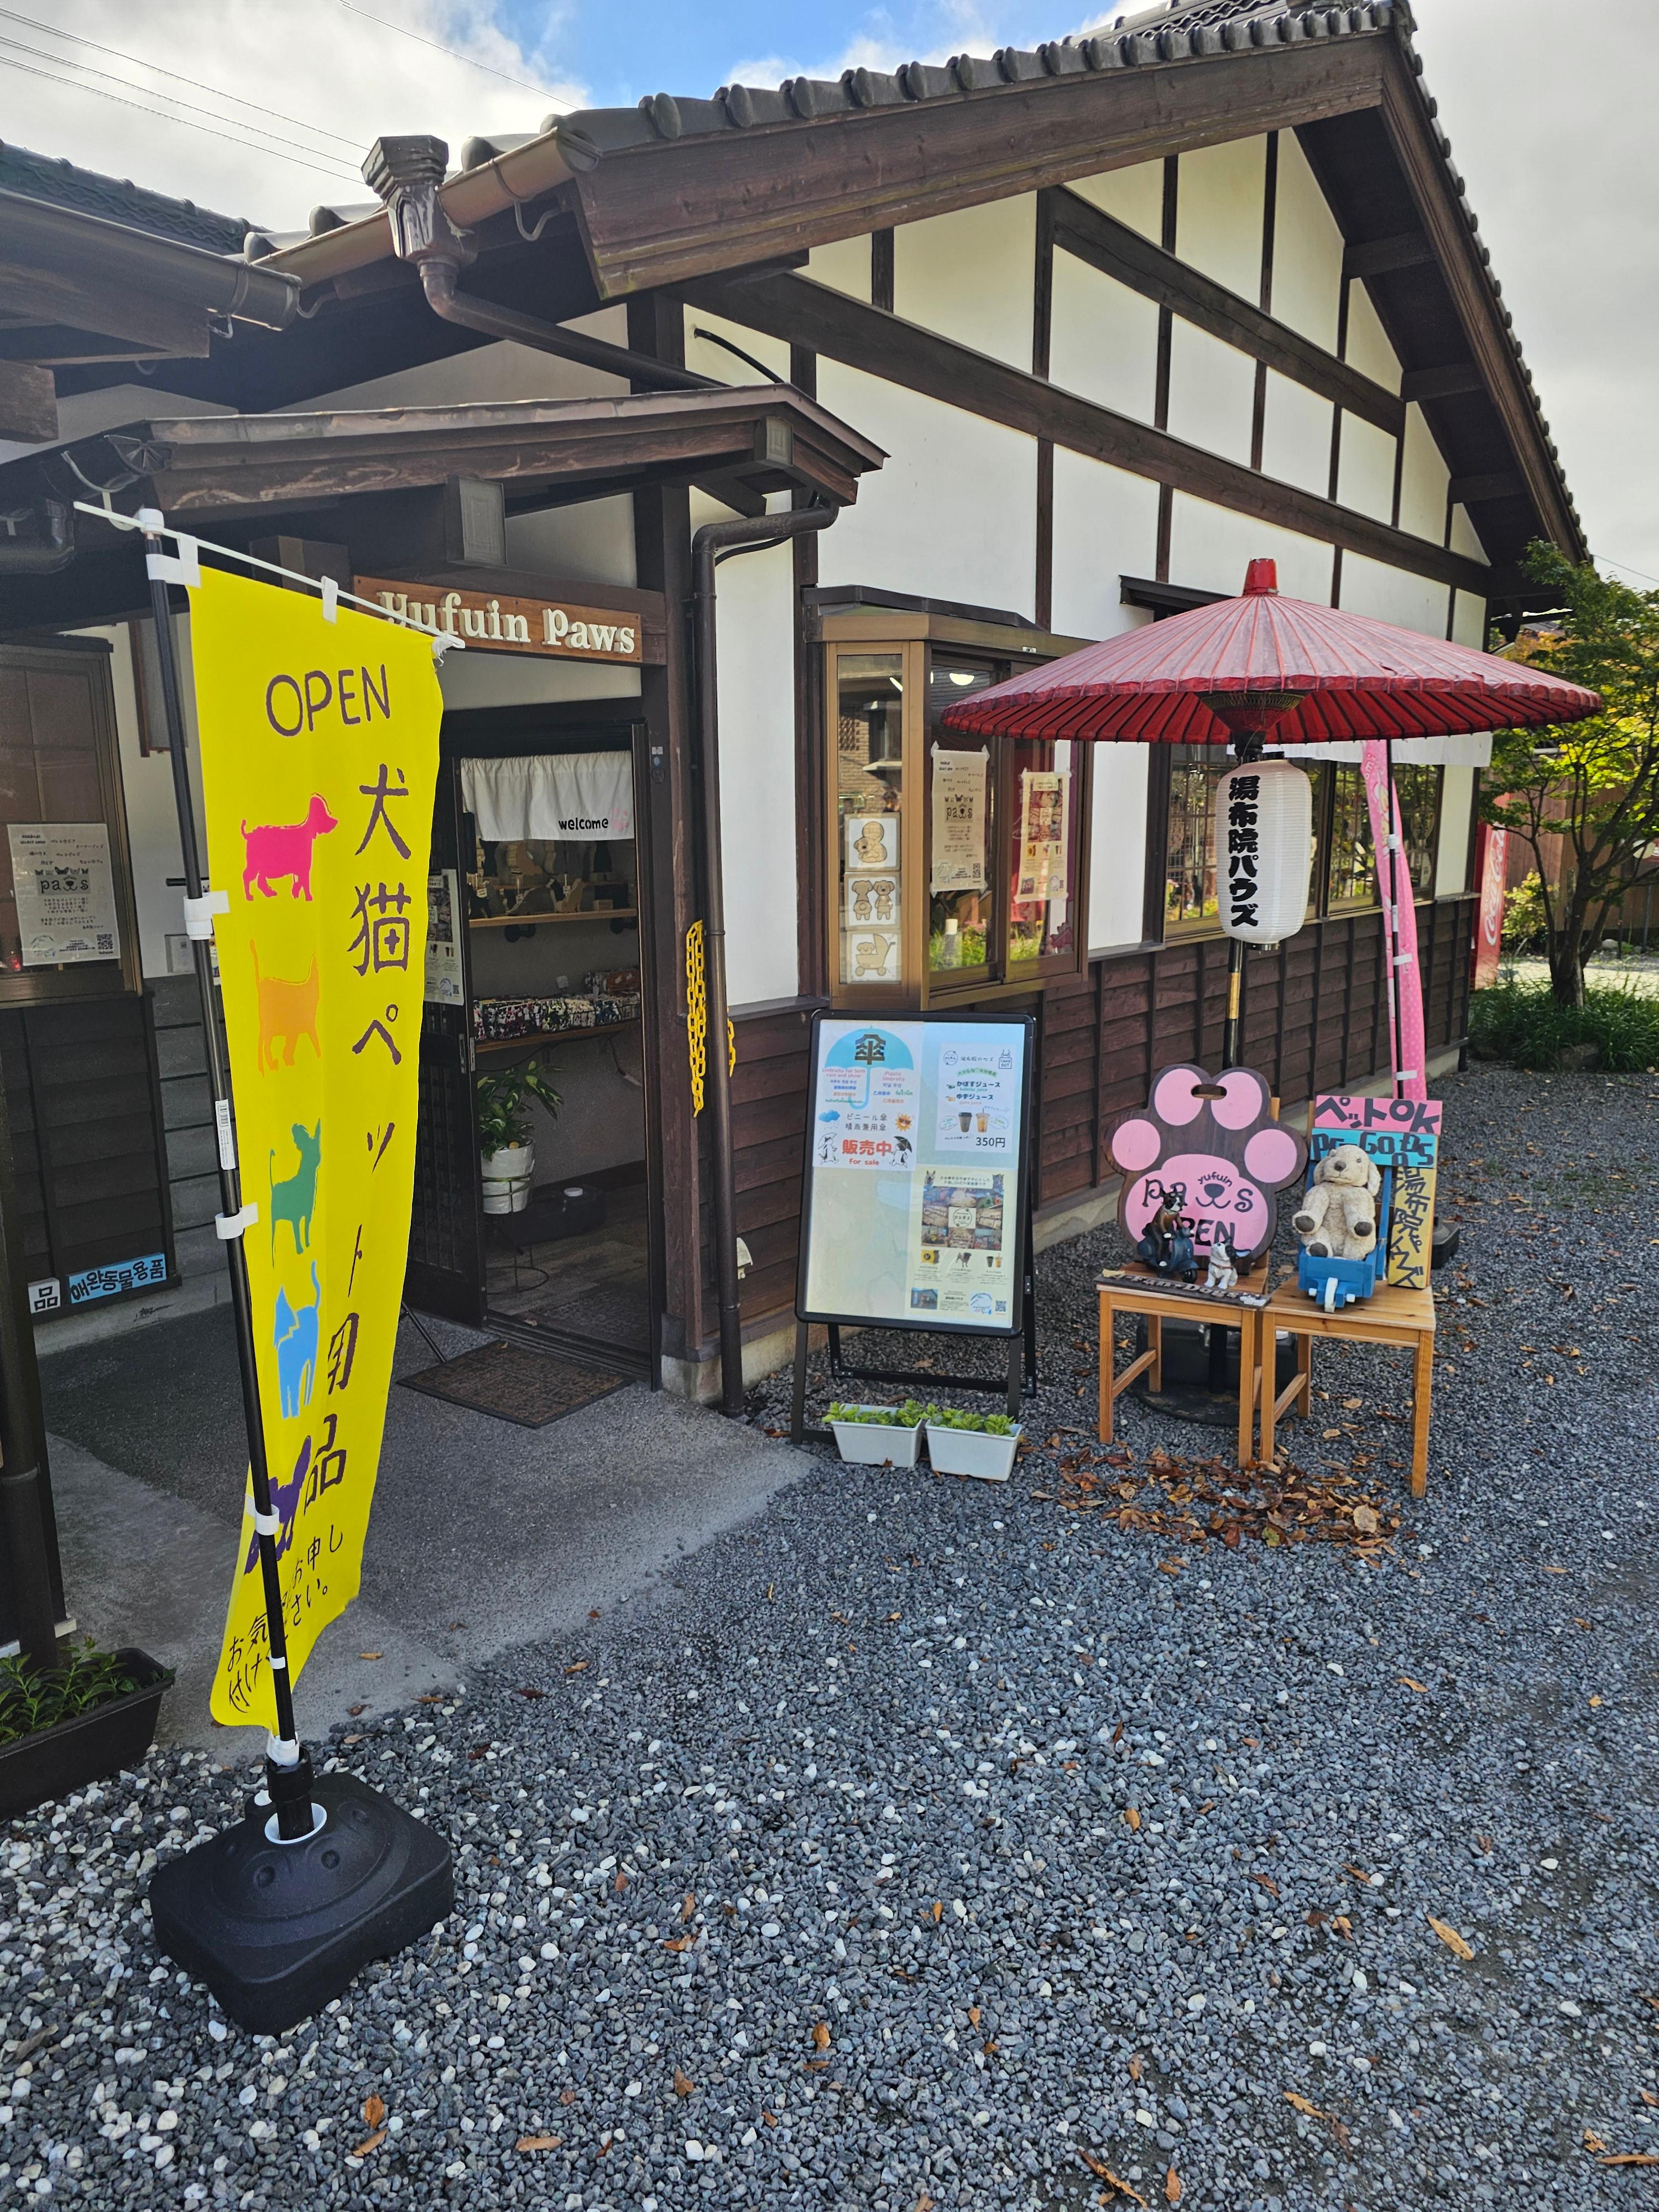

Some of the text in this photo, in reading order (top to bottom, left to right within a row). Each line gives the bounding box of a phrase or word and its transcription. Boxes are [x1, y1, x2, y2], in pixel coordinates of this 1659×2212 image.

[266, 663, 390, 738] OPEN
[558, 816, 609, 831] welcome
[1228, 775, 1261, 928] 湯布院パウズ
[854, 1034, 886, 1065] 傘
[847, 1113, 887, 1121] ビニール傘
[842, 1139, 892, 1156] 販売中
[975, 1137, 1006, 1148] 350円
[1197, 1171, 1233, 1187] yufuin
[1176, 1217, 1235, 1246] PEN
[1390, 1167, 1431, 1287] 湯布院パウズ
[70, 1258, 165, 1301] 애완동물용품
[34, 1286, 59, 1311] 品
